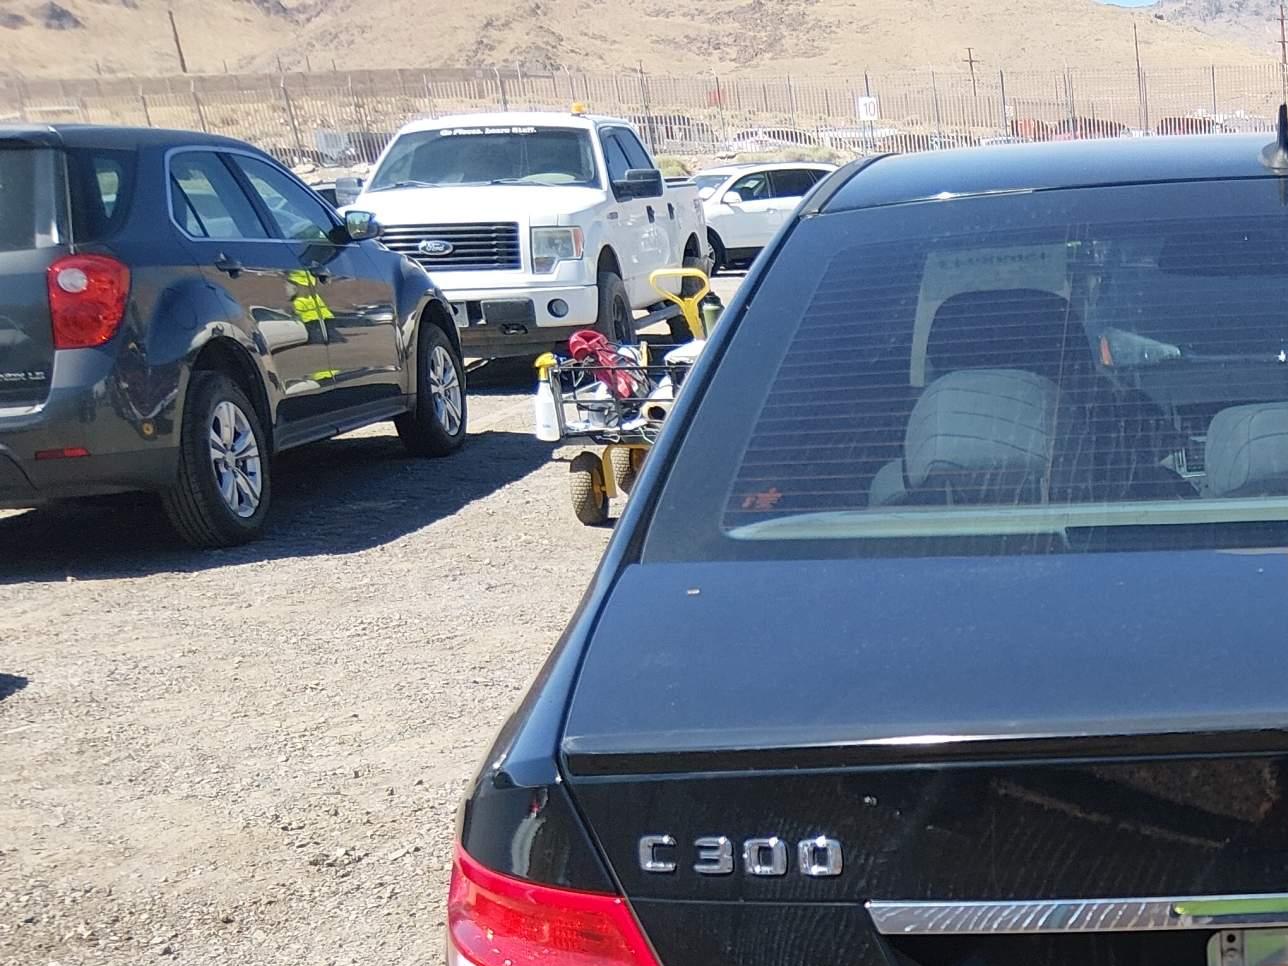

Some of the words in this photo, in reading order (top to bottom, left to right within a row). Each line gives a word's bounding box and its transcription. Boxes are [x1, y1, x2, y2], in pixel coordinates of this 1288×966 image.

[864, 101, 876, 116] 10
[638, 835, 677, 872] C
[693, 835, 844, 876] 300
